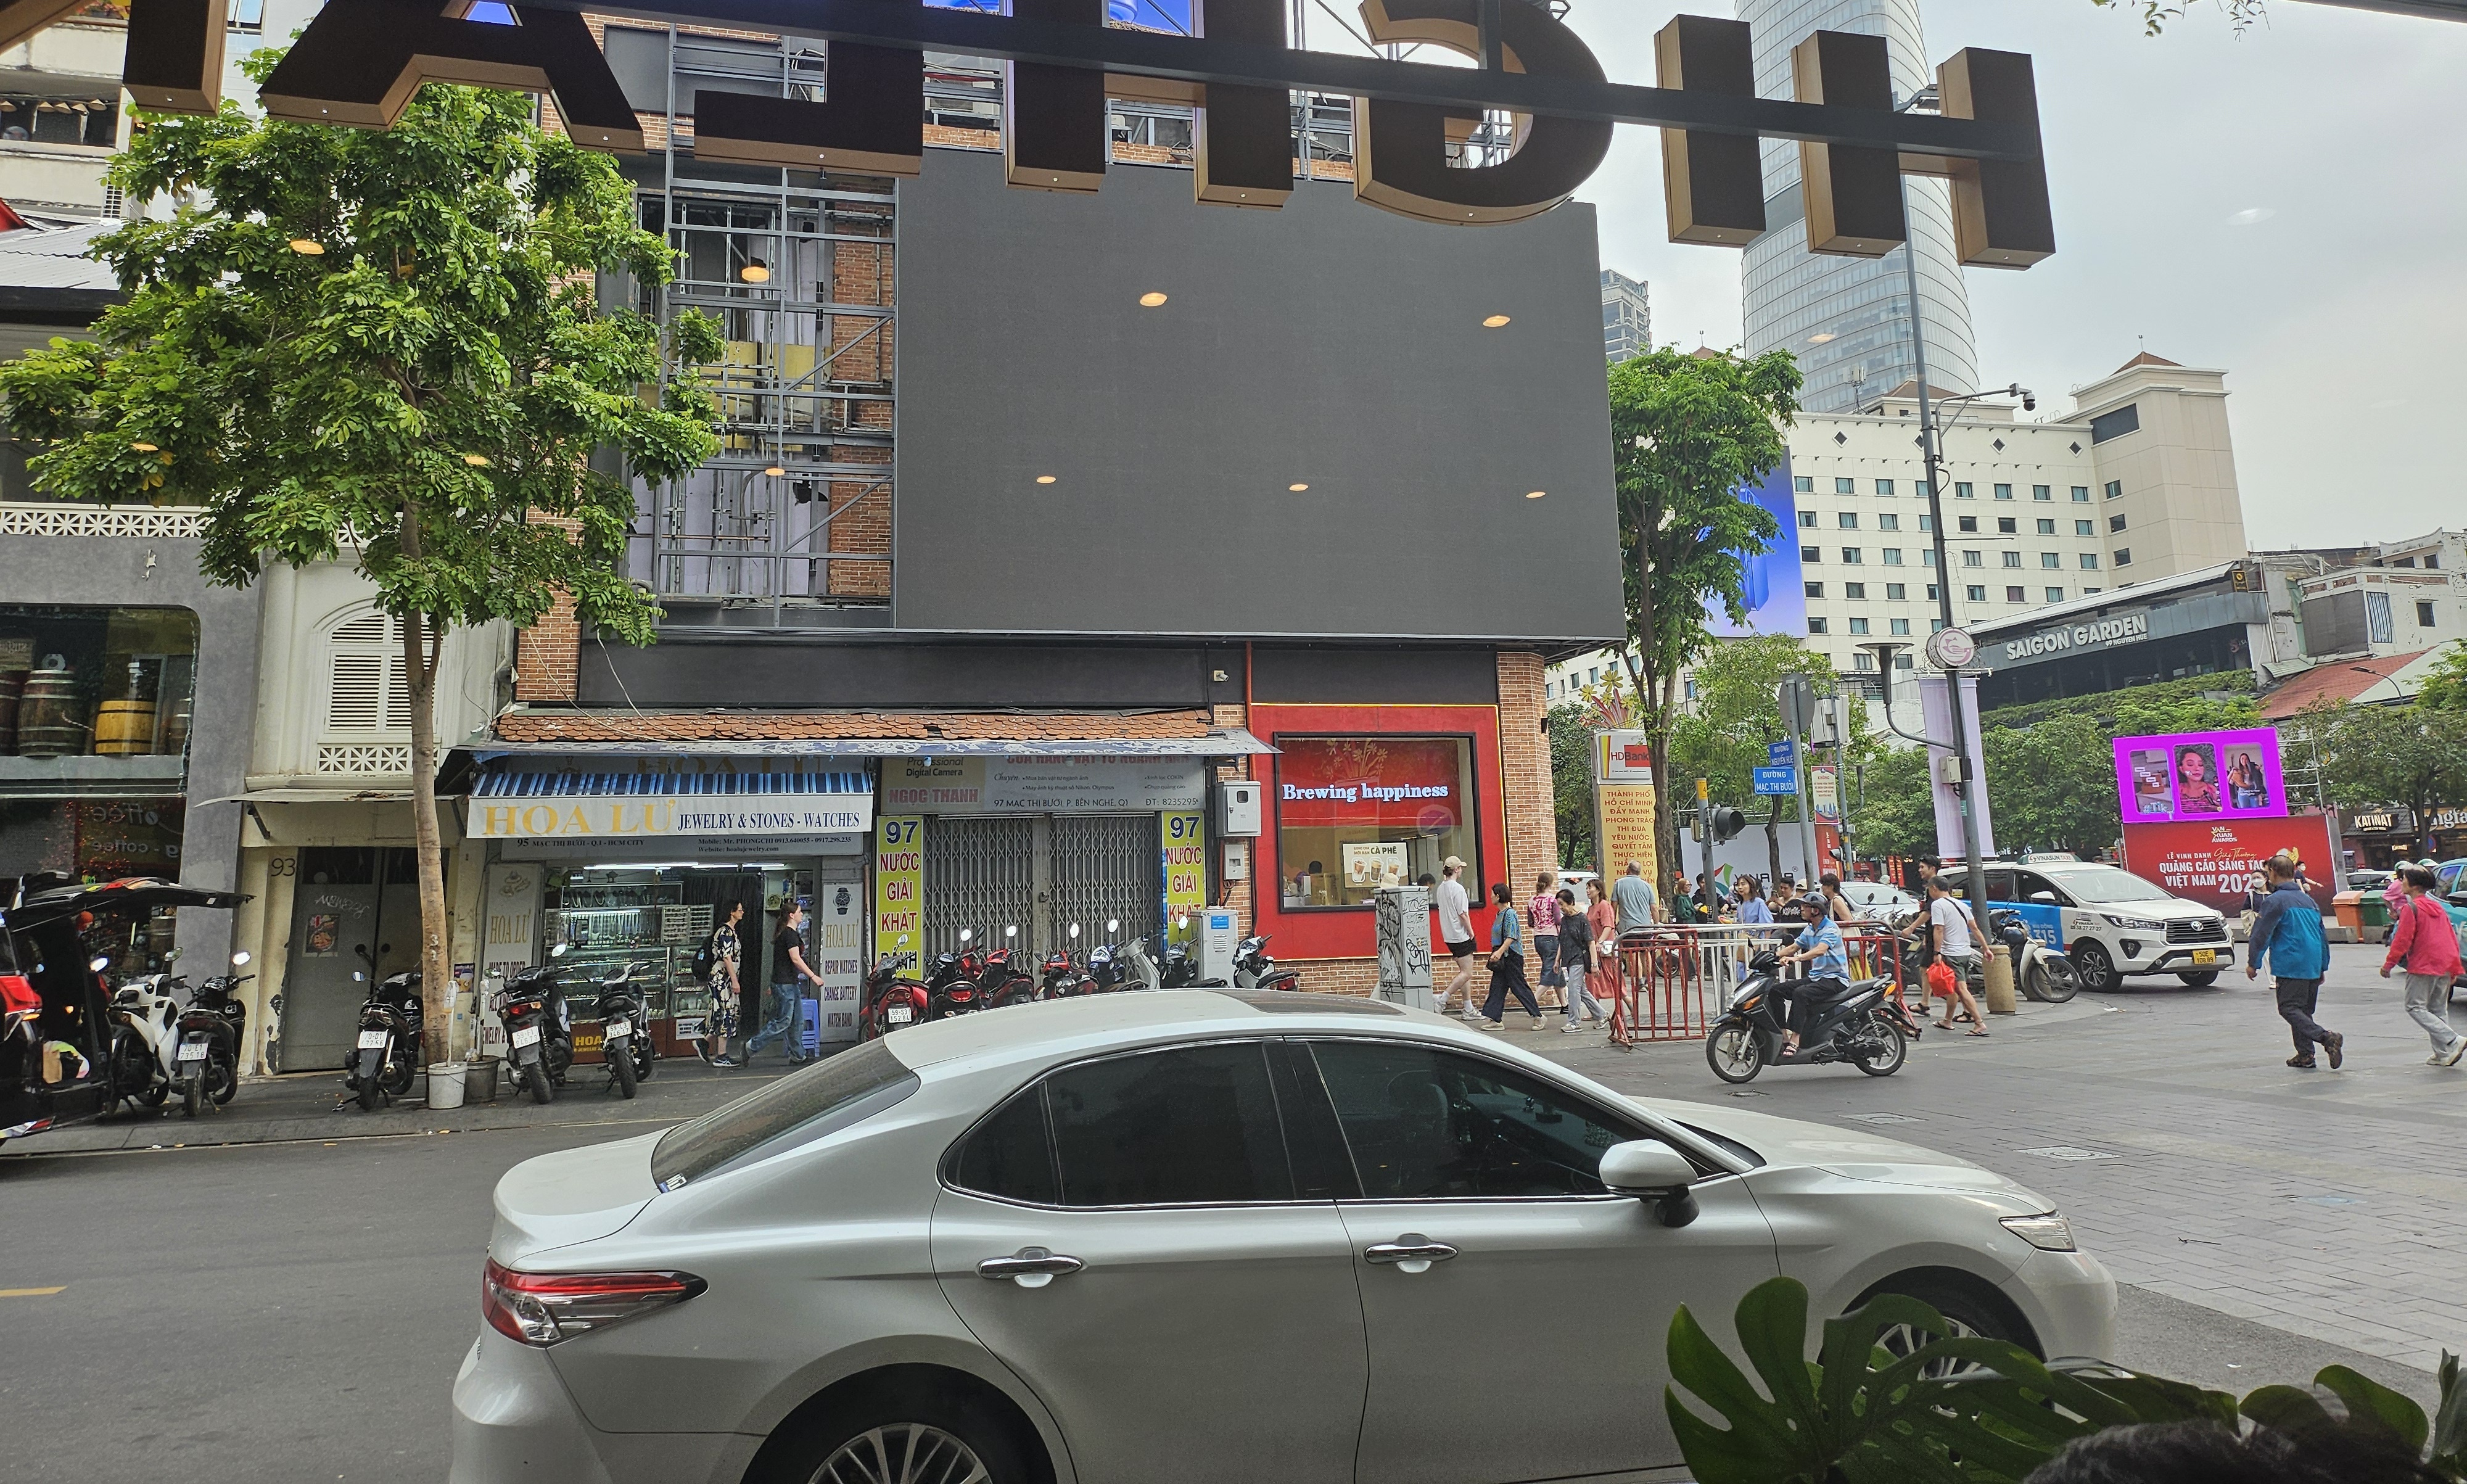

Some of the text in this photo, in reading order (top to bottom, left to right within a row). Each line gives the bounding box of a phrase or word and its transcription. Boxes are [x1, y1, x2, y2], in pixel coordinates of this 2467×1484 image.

[2007, 614, 2148, 660] SAIGON GARDEN
[2113, 636, 2135, 646] NGUYEN
[1611, 751, 1649, 761] HDBank
[906, 769, 931, 778] Digital
[1762, 770, 1787, 778] ĐƯỜNG
[1282, 783, 1449, 802] Brewing happiness
[1636, 789, 1650, 798] PHỐ
[1757, 782, 1769, 793] MẠC
[1769, 781, 1780, 792] THỊ
[889, 788, 979, 806] NGỌC THANH
[1066, 799, 1073, 807] P.
[1146, 798, 1159, 806] ĐT:
[1605, 798, 1617, 806] HỒ
[482, 799, 676, 835] HOA LƯ
[1610, 806, 1626, 814] ĐẨY
[678, 813, 735, 831] JEWELRY
[738, 813, 748, 828] &
[750, 812, 794, 829] STONES
[804, 812, 860, 828] WATCHES
[1170, 816, 1200, 839] 97
[2354, 814, 2392, 828] KATINAT
[886, 820, 918, 844] 97
[517, 838, 529, 847] 95
[1612, 841, 1636, 849] QUYẾT
[1166, 843, 1202, 865] NƯỚC
[1370, 846, 1398, 854] CÀ PHÊ
[1637, 851, 1653, 859] HIỆN
[2167, 852, 2174, 860] LỄ
[271, 858, 296, 876] 93
[880, 848, 920, 872] NƯỚC
[1642, 860, 1654, 868] LỢI
[2159, 857, 2245, 873] QUẢNG CÁO SÁNG
[1172, 870, 1196, 892] GIẢI
[2165, 872, 2188, 889] VIỆT
[2191, 874, 2217, 886] NAM
[887, 877, 912, 901] GIẢI
[489, 908, 531, 944] HOA LƯ
[881, 907, 917, 933] KHÁT
[825, 918, 859, 948] HOA LƯ
[825, 959, 858, 975] REPAIR WATCHES
[824, 986, 857, 1001] CHANGE BATTERY
[609, 1022, 627, 1032] 59-L3
[828, 1012, 852, 1028] WATCH BAND
[516, 1028, 534, 1039] 59-F1
[516, 1034, 538, 1047] 846.73
[575, 1036, 603, 1046] HOA
